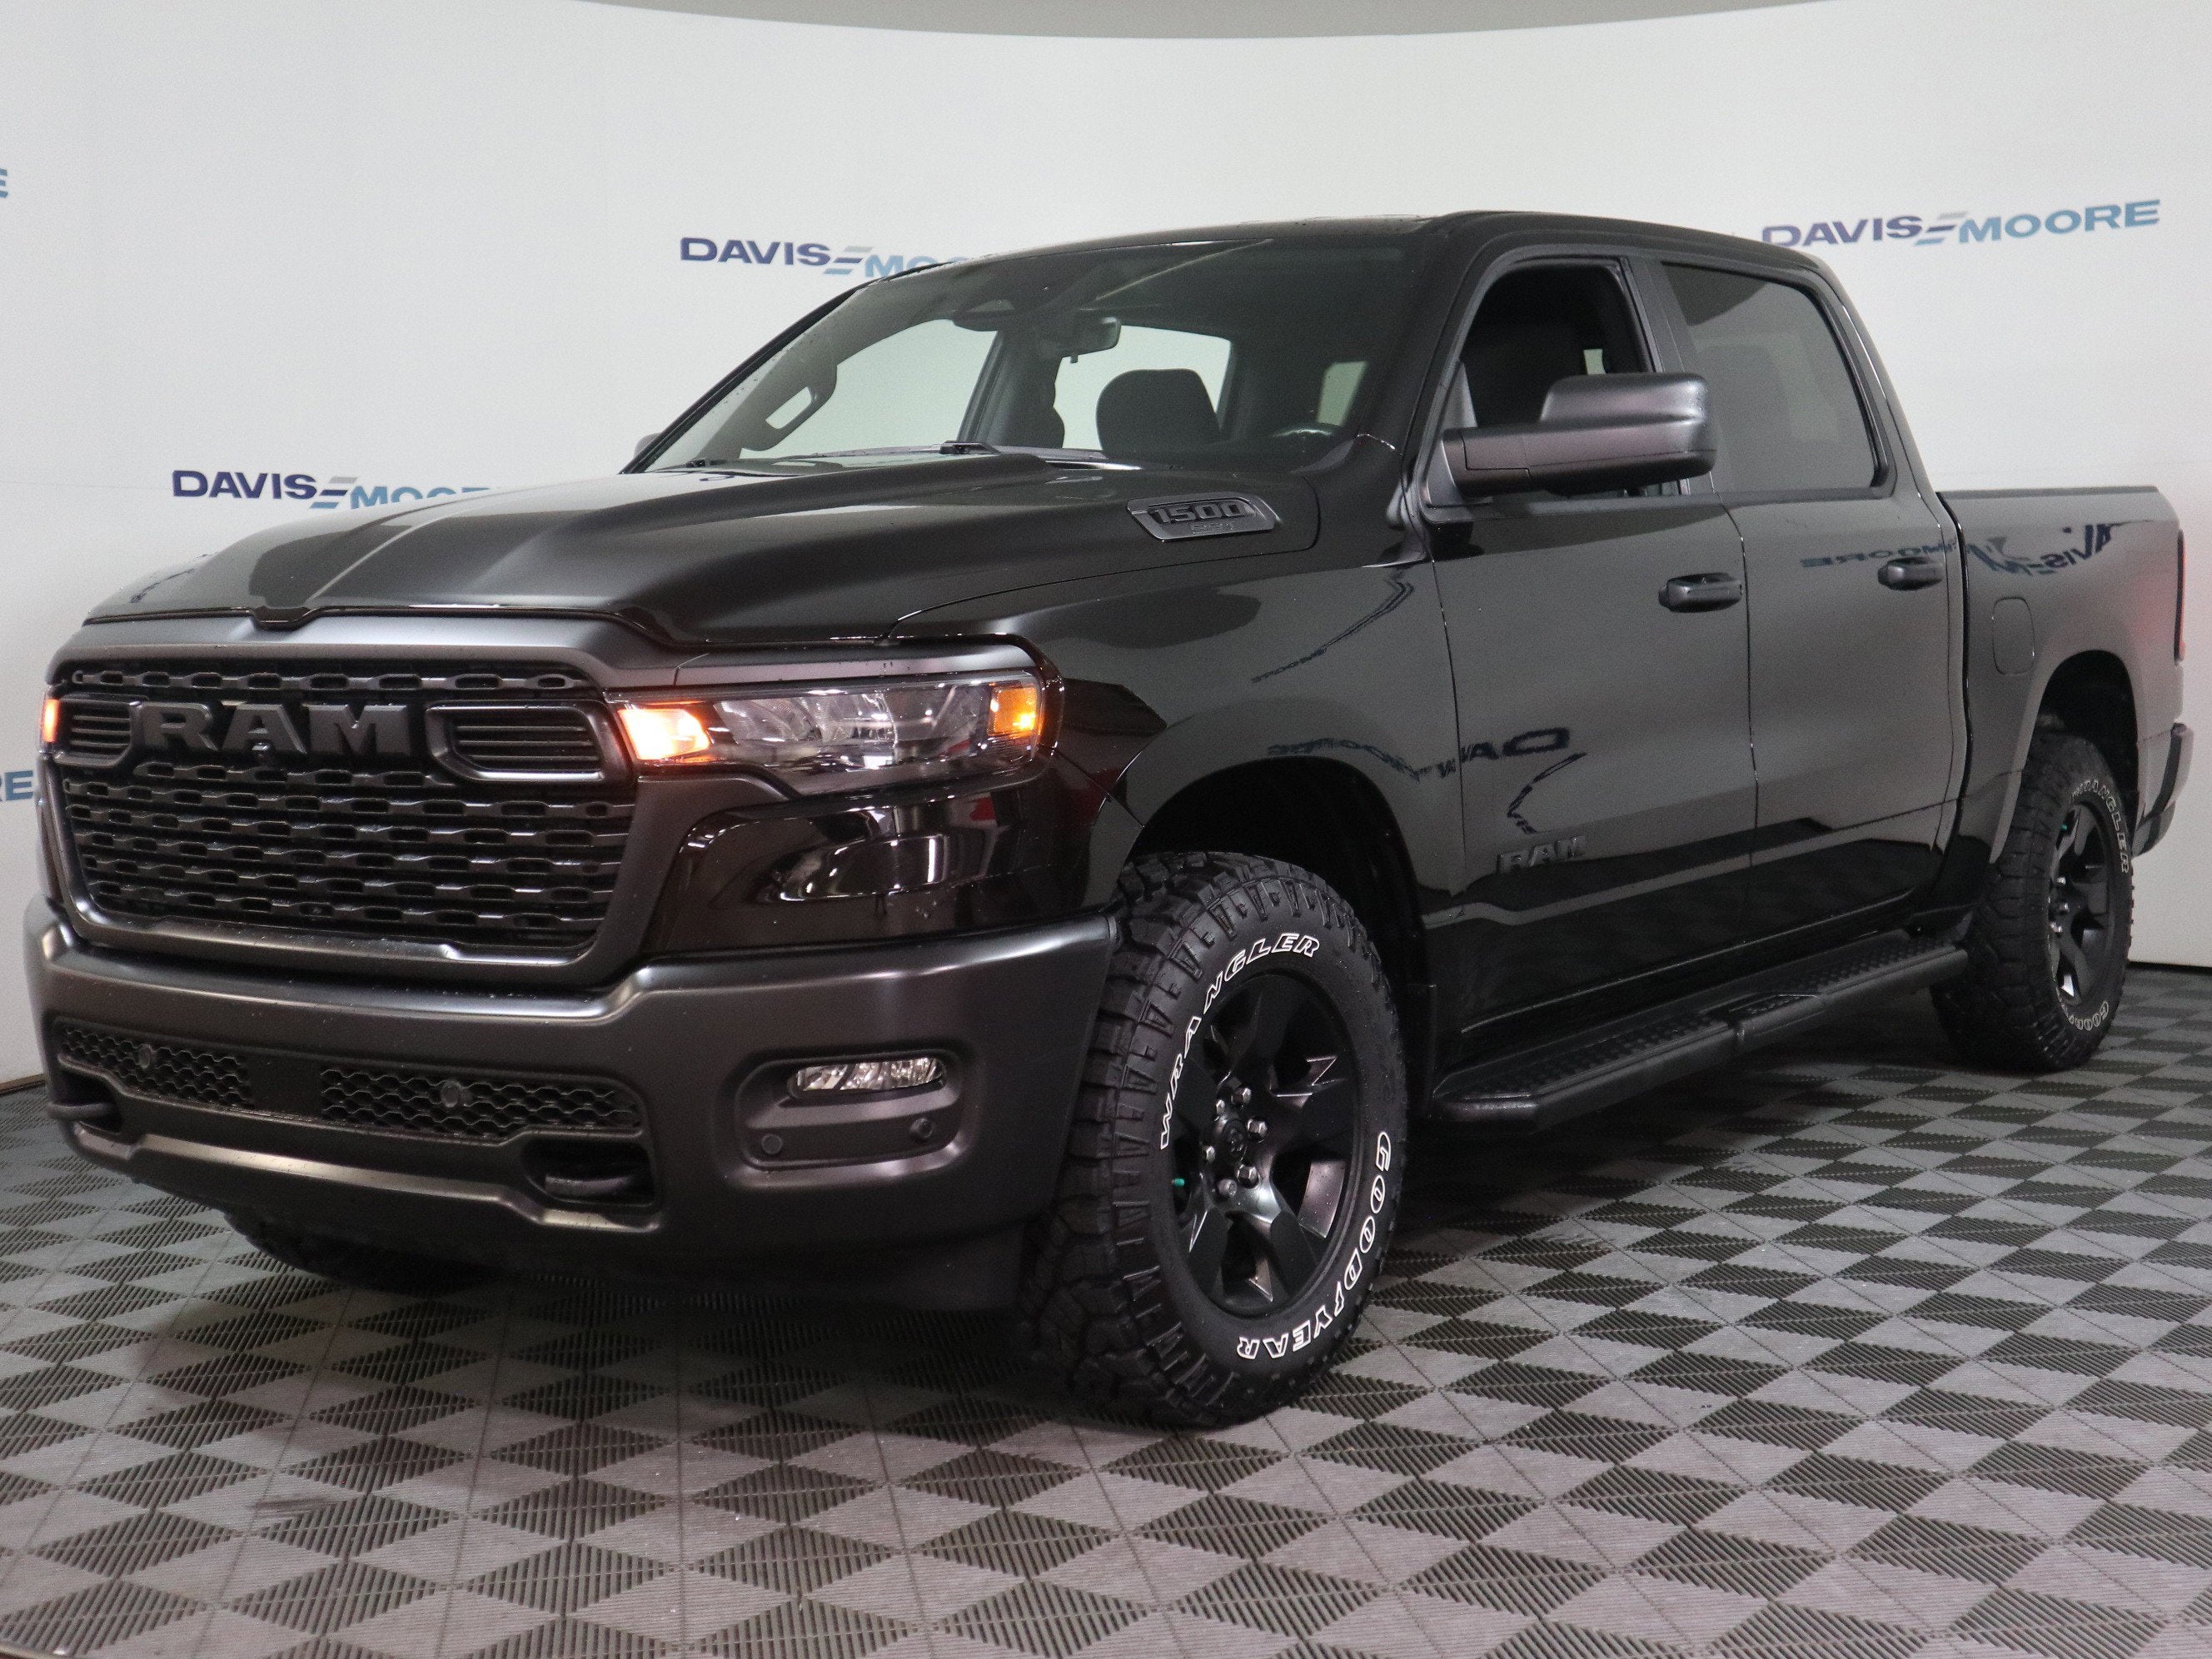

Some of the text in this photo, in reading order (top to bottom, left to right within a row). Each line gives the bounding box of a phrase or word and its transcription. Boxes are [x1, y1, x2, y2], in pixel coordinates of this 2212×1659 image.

[1761, 198, 2161, 247] DAVIS MOORE
[680, 237, 831, 266] DAVIS
[172, 470, 317, 500] DAVIS
[1148, 501, 1246, 524] 1500
[129, 700, 411, 755] RAM
[1497, 834, 1586, 873] RAM
[1160, 932, 1320, 1150] WRANGLER
[1236, 1130, 1392, 1360] GOODYEAR
